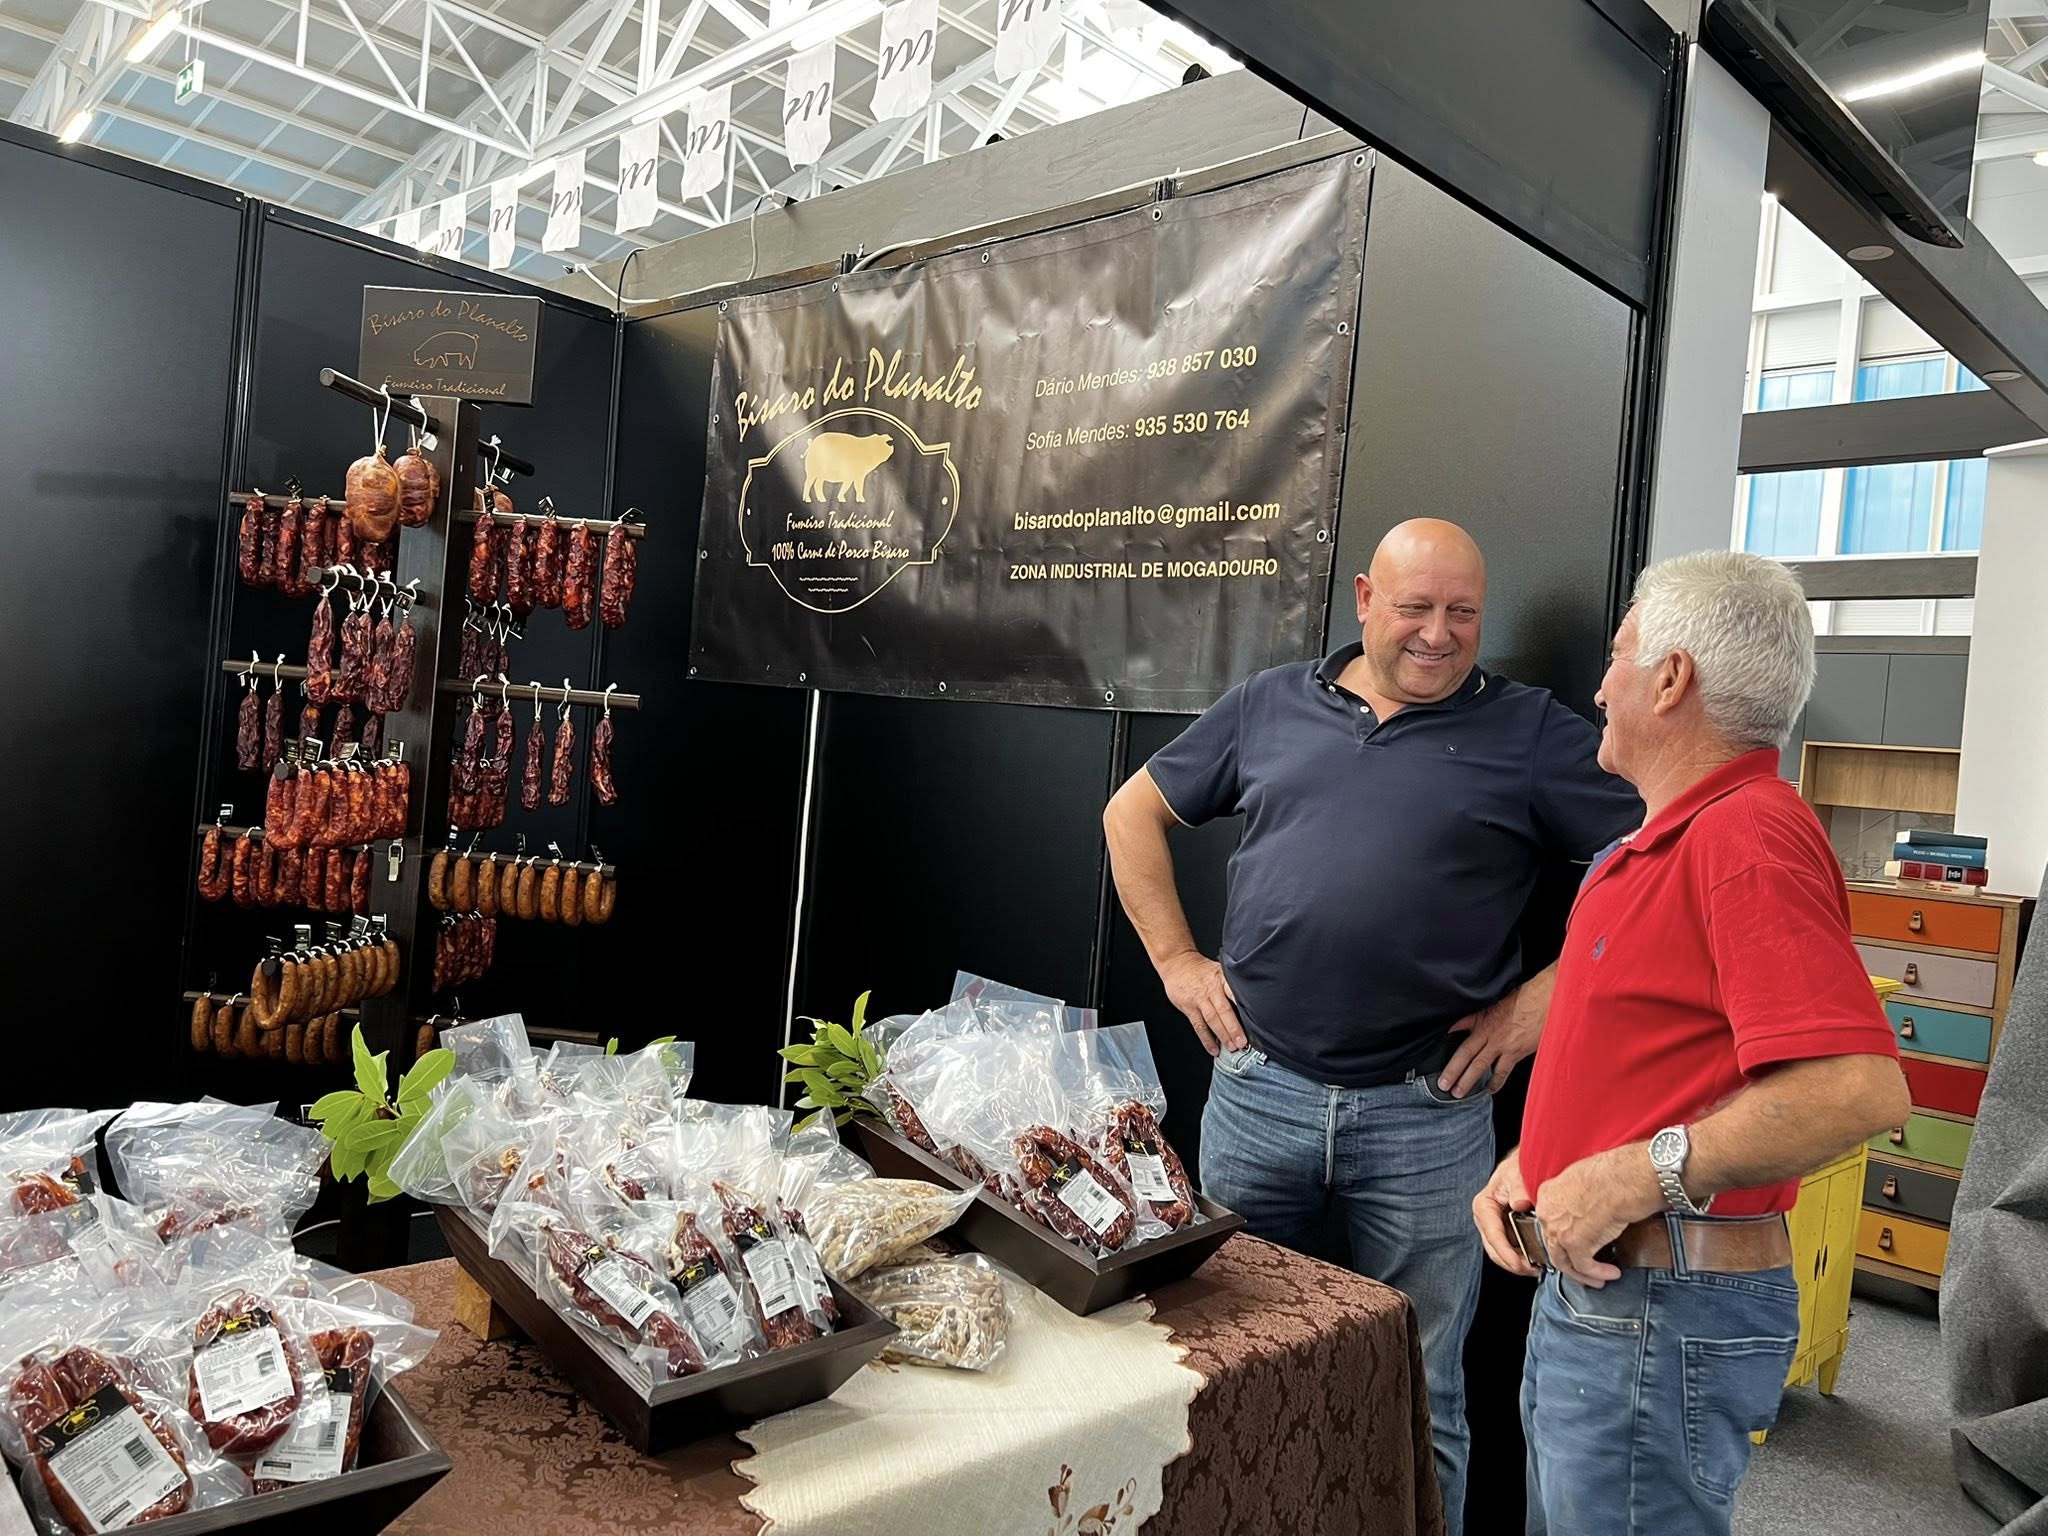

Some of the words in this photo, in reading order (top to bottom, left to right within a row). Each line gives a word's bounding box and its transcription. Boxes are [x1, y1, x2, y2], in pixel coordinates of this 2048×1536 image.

[431, 300, 451, 318] do
[458, 300, 527, 342] Planalto
[384, 375, 433, 390] Fumeiro
[437, 378, 505, 396] Tradicional
[823, 356, 854, 406] do
[864, 347, 983, 410] Planalto
[1035, 376, 1074, 398] Dário
[1077, 367, 1143, 392] Mendes:
[1146, 358, 1177, 380] 938
[1181, 350, 1215, 374] 857
[1219, 345, 1257, 369] 030
[1026, 432, 1062, 451] Sofia
[1065, 422, 1130, 446] Mendes:
[1134, 415, 1167, 438] 935
[1172, 411, 1208, 434] 530
[1213, 408, 1250, 431] 764
[786, 512, 825, 532] Fumeiro
[827, 510, 895, 531] Tradicional
[1014, 500, 1280, 532] bisarodoplanalto@gmail.com
[771, 541, 795, 561] 100%
[797, 543, 823, 560] Carne
[824, 541, 837, 559] de
[838, 540, 869, 560] Porco
[1010, 564, 1047, 580] ZONA
[1050, 562, 1137, 580] INDUSTRIAL
[1141, 562, 1163, 578] DE
[1167, 558, 1278, 578] MOGADOURO
